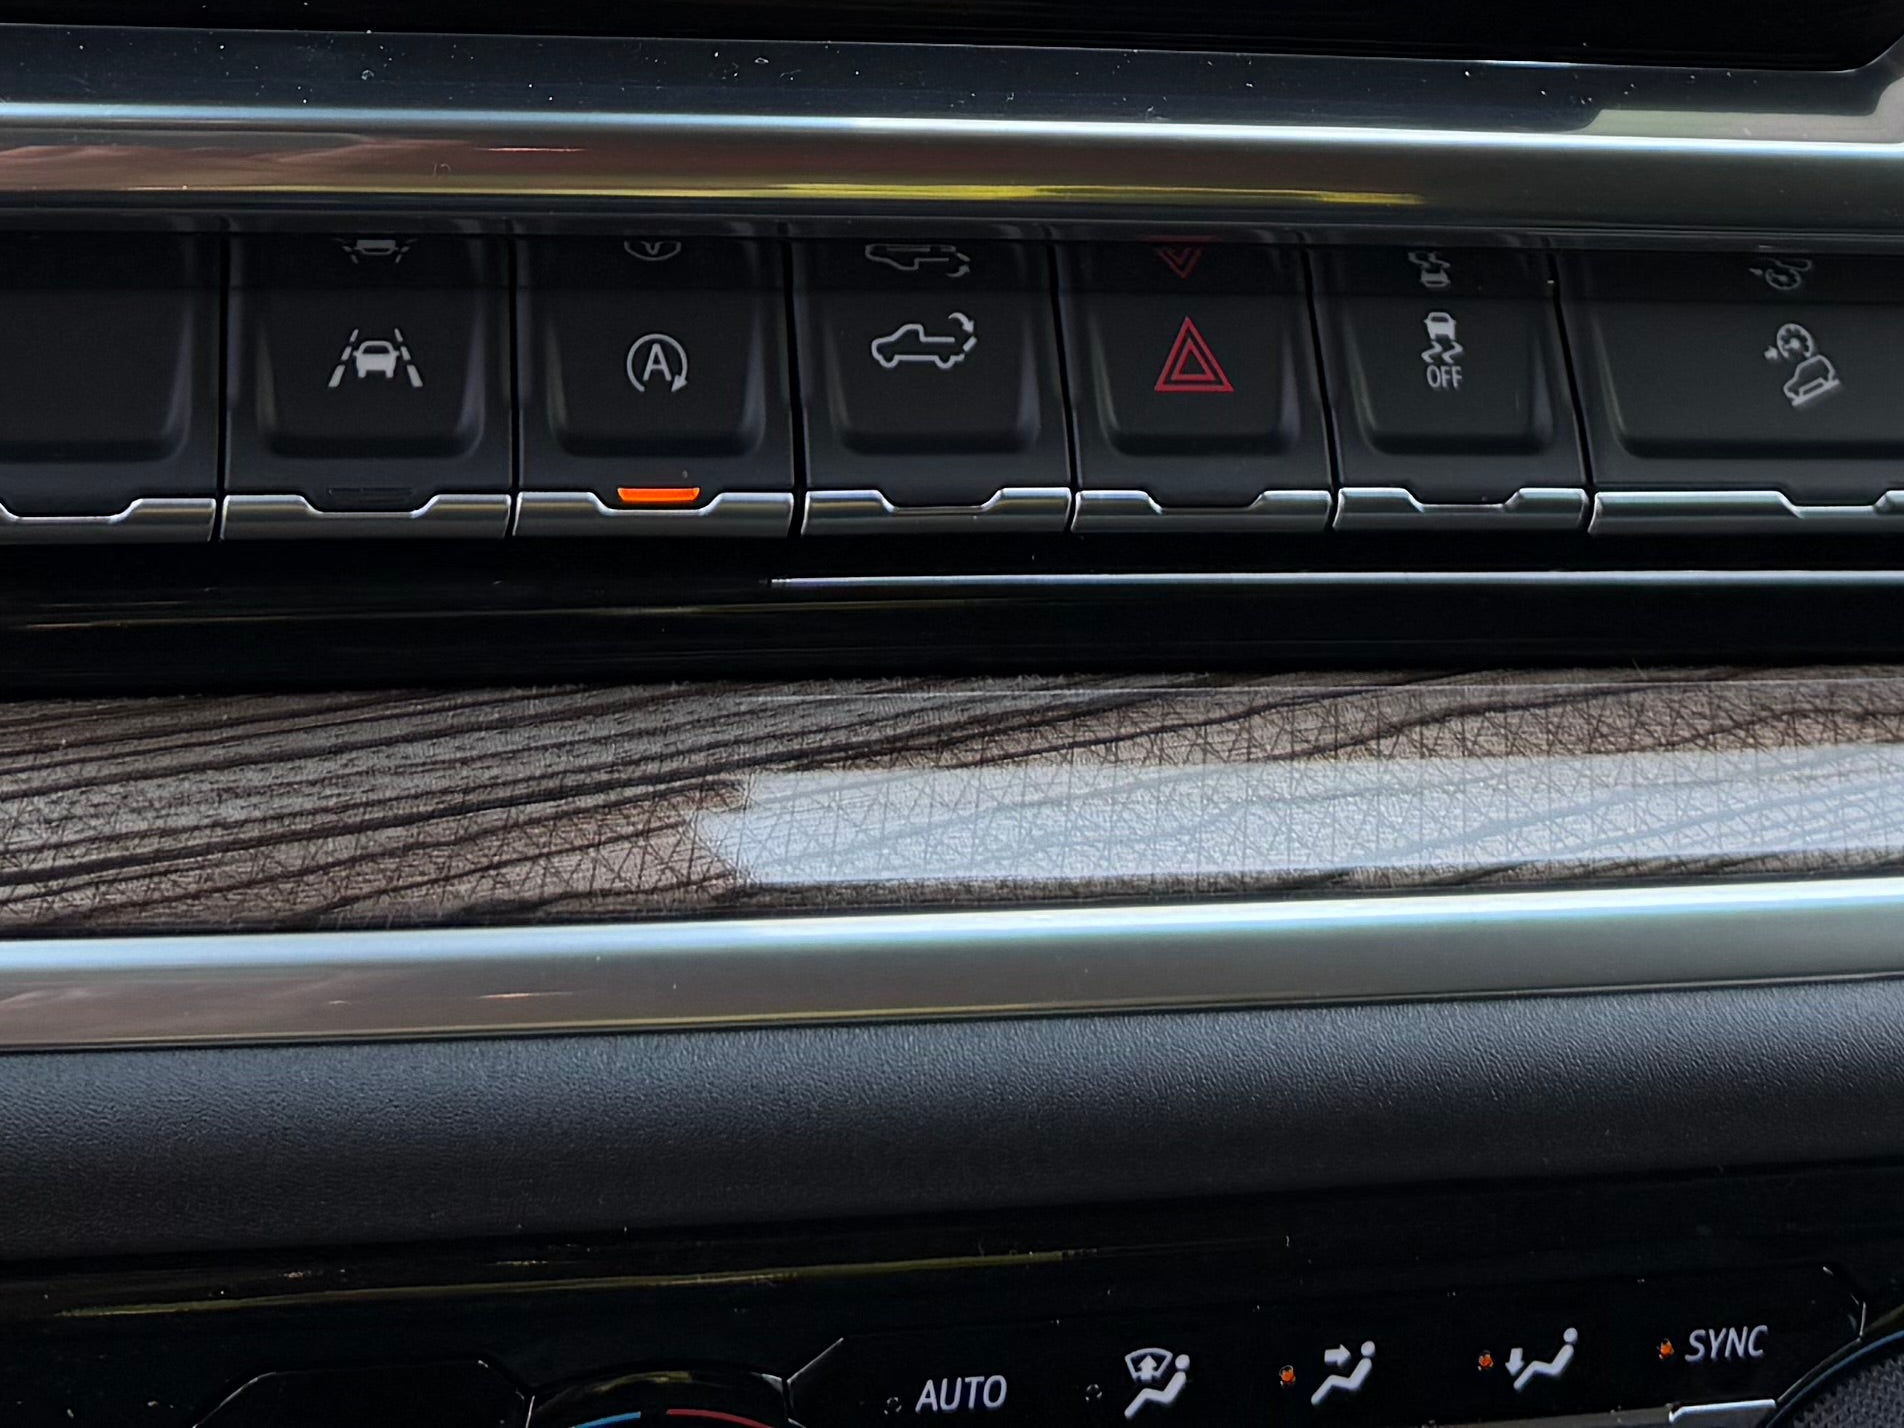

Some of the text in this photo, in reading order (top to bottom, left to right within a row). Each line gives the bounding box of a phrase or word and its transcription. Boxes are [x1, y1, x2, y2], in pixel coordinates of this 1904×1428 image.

[1426, 364, 1463, 388] OFF
[1684, 1325, 1769, 1363] SYNC
[915, 1374, 1008, 1412] AUTO
